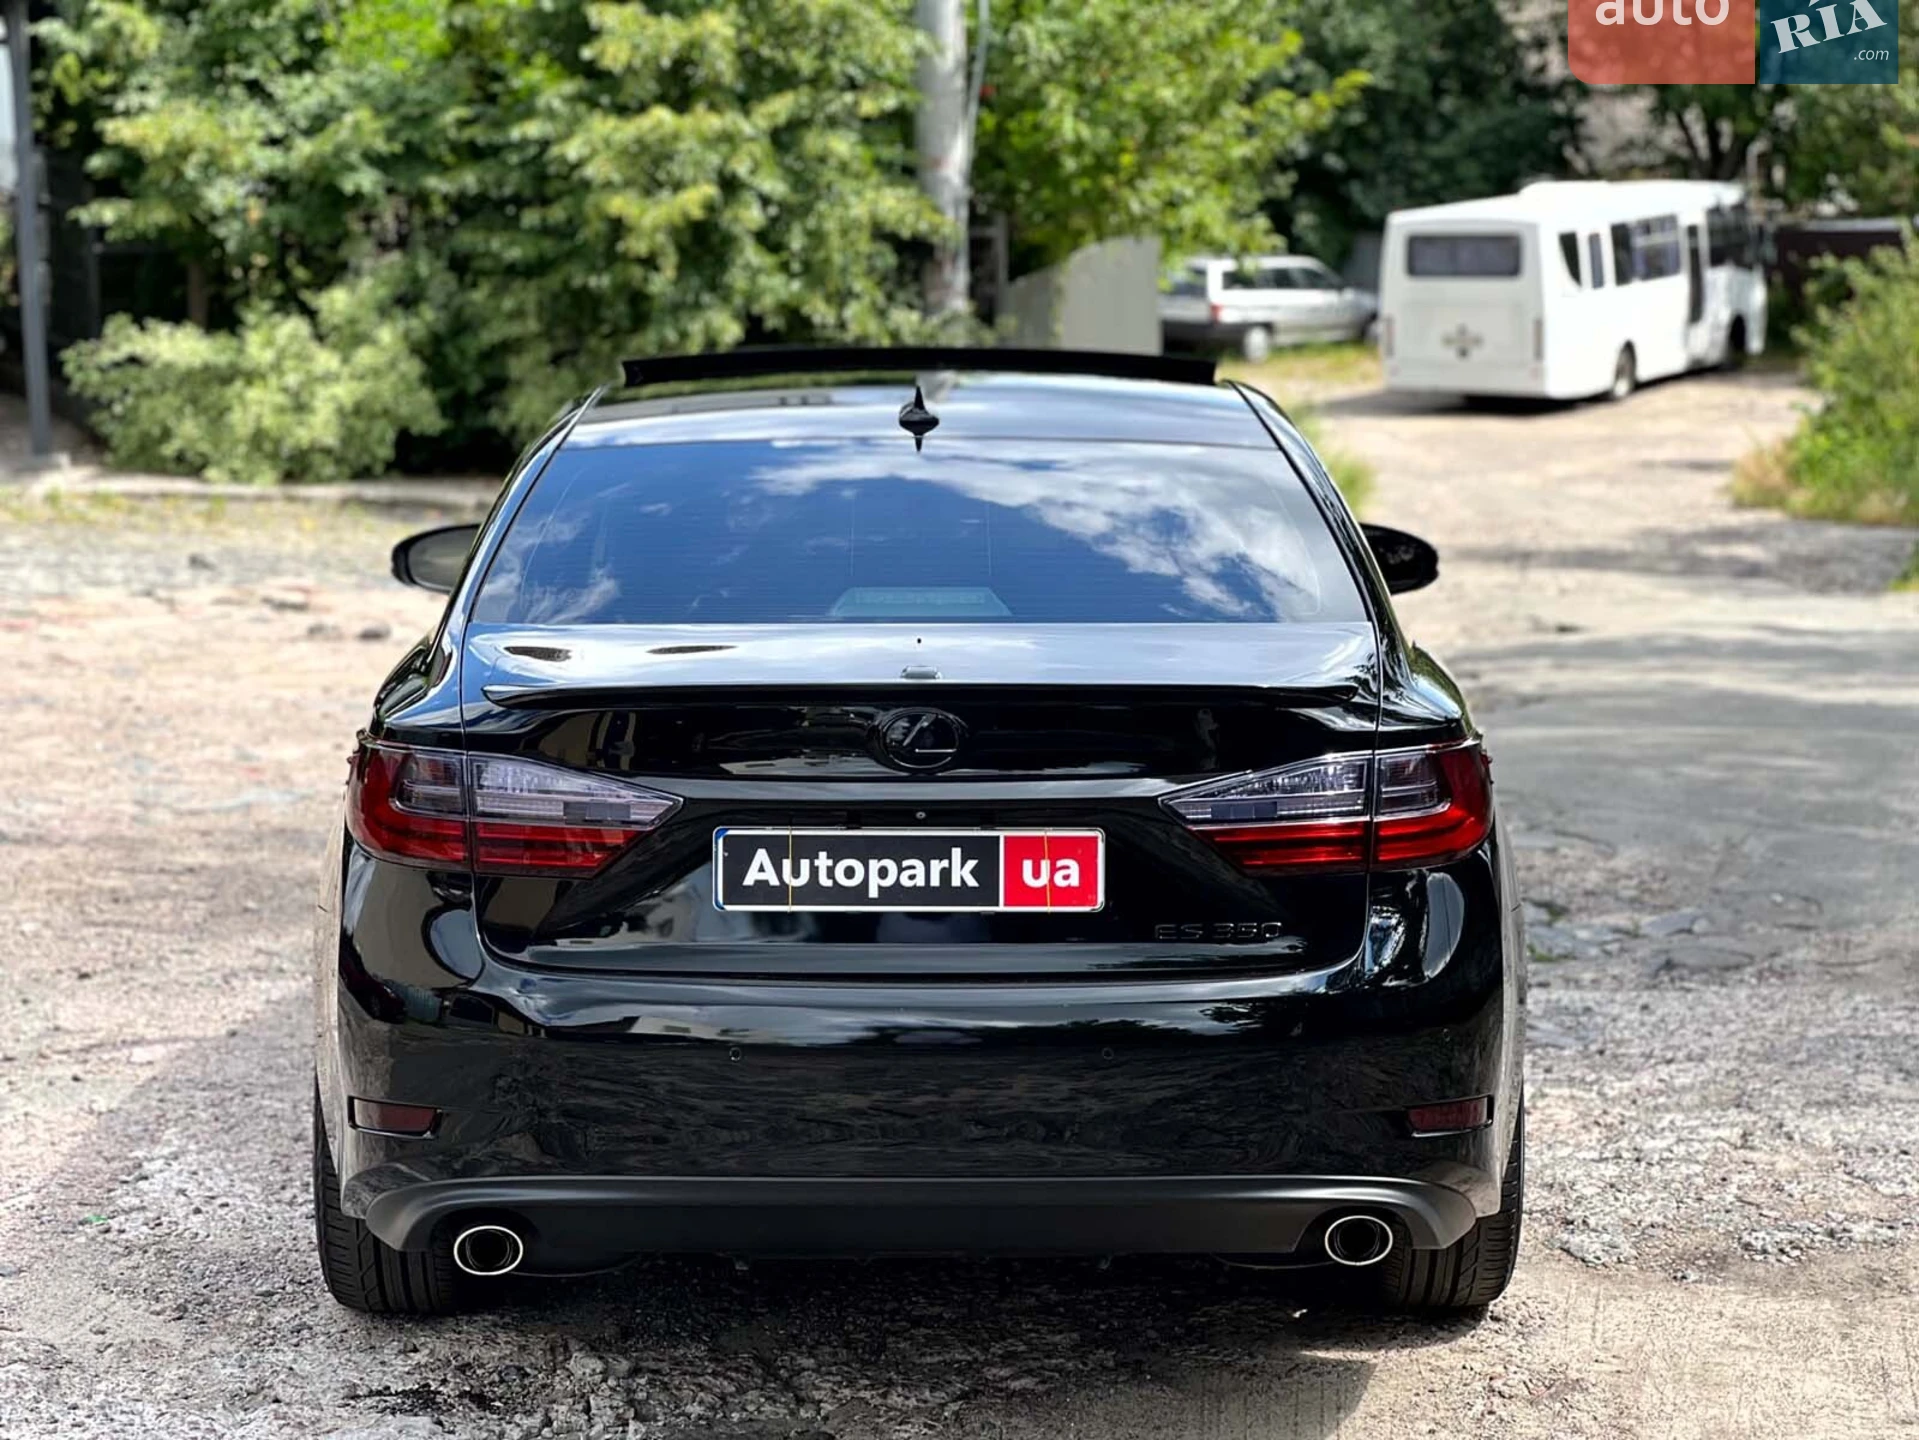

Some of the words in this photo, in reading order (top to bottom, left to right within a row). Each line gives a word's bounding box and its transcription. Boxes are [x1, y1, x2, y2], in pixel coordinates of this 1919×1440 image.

[742, 848, 980, 898] Autopark
[1022, 858, 1081, 888] ua
[1155, 924, 1203, 939] ES
[1213, 922, 1282, 939] 350
